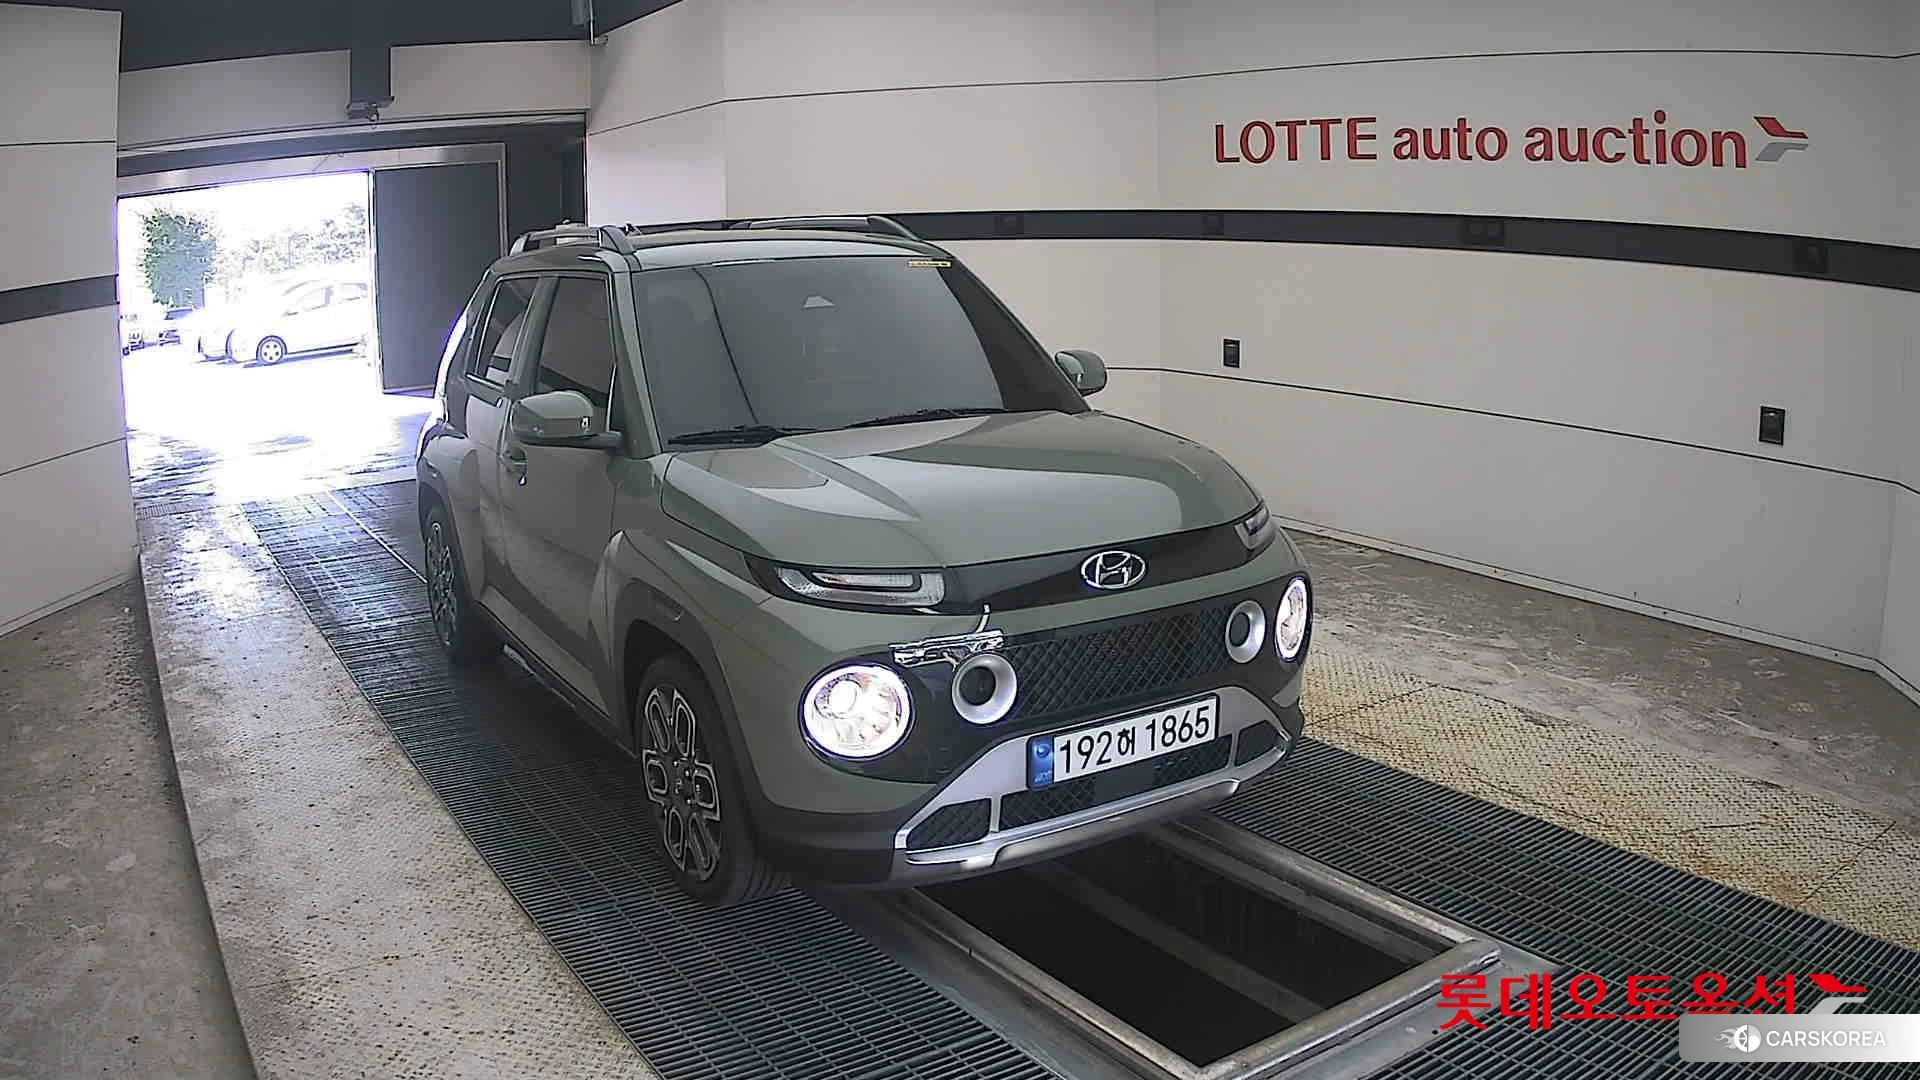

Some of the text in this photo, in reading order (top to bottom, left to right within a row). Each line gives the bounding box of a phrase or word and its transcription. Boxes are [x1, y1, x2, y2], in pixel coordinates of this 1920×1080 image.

[1214, 110, 1748, 168] LOTTE auto auction
[1059, 705, 1210, 774] 192허 1865
